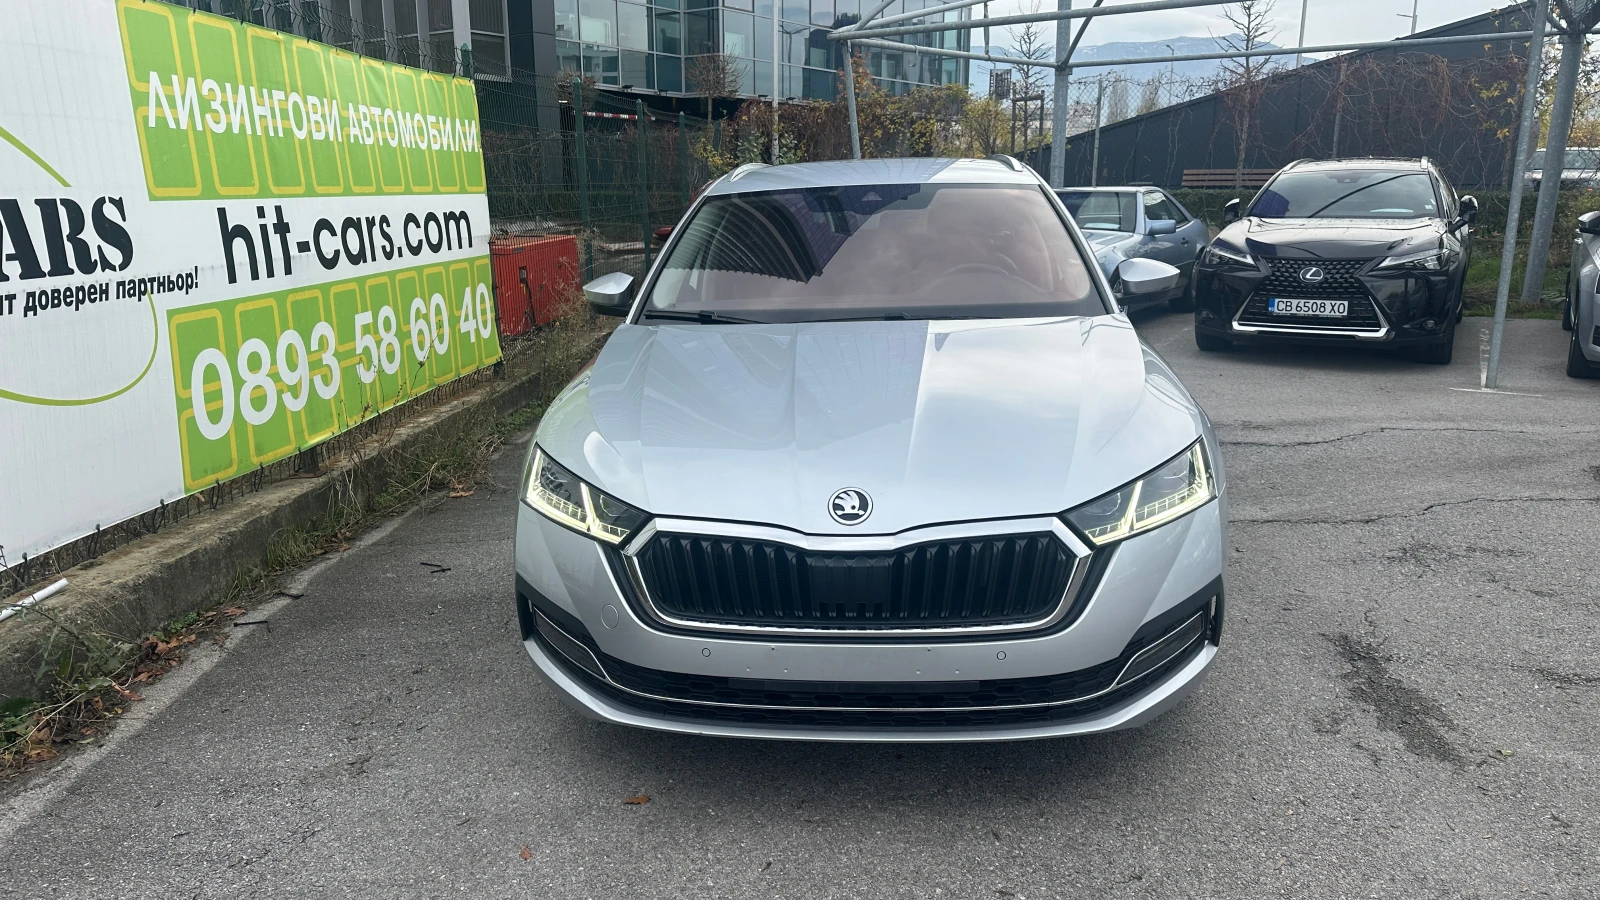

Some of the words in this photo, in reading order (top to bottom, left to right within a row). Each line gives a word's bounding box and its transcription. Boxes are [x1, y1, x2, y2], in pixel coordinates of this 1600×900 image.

[148, 71, 342, 142] ЛИЗИНГОВИ
[348, 102, 479, 153] АВТОМОБИЛИ
[217, 204, 474, 284] hit-cars.com
[23, 282, 110, 318] доверен
[115, 265, 199, 302] партньор!
[1295, 301, 1326, 313] 6508
[191, 321, 341, 440] 0893
[355, 305, 401, 384] 58
[409, 292, 450, 363] 60
[459, 282, 492, 343] 40
